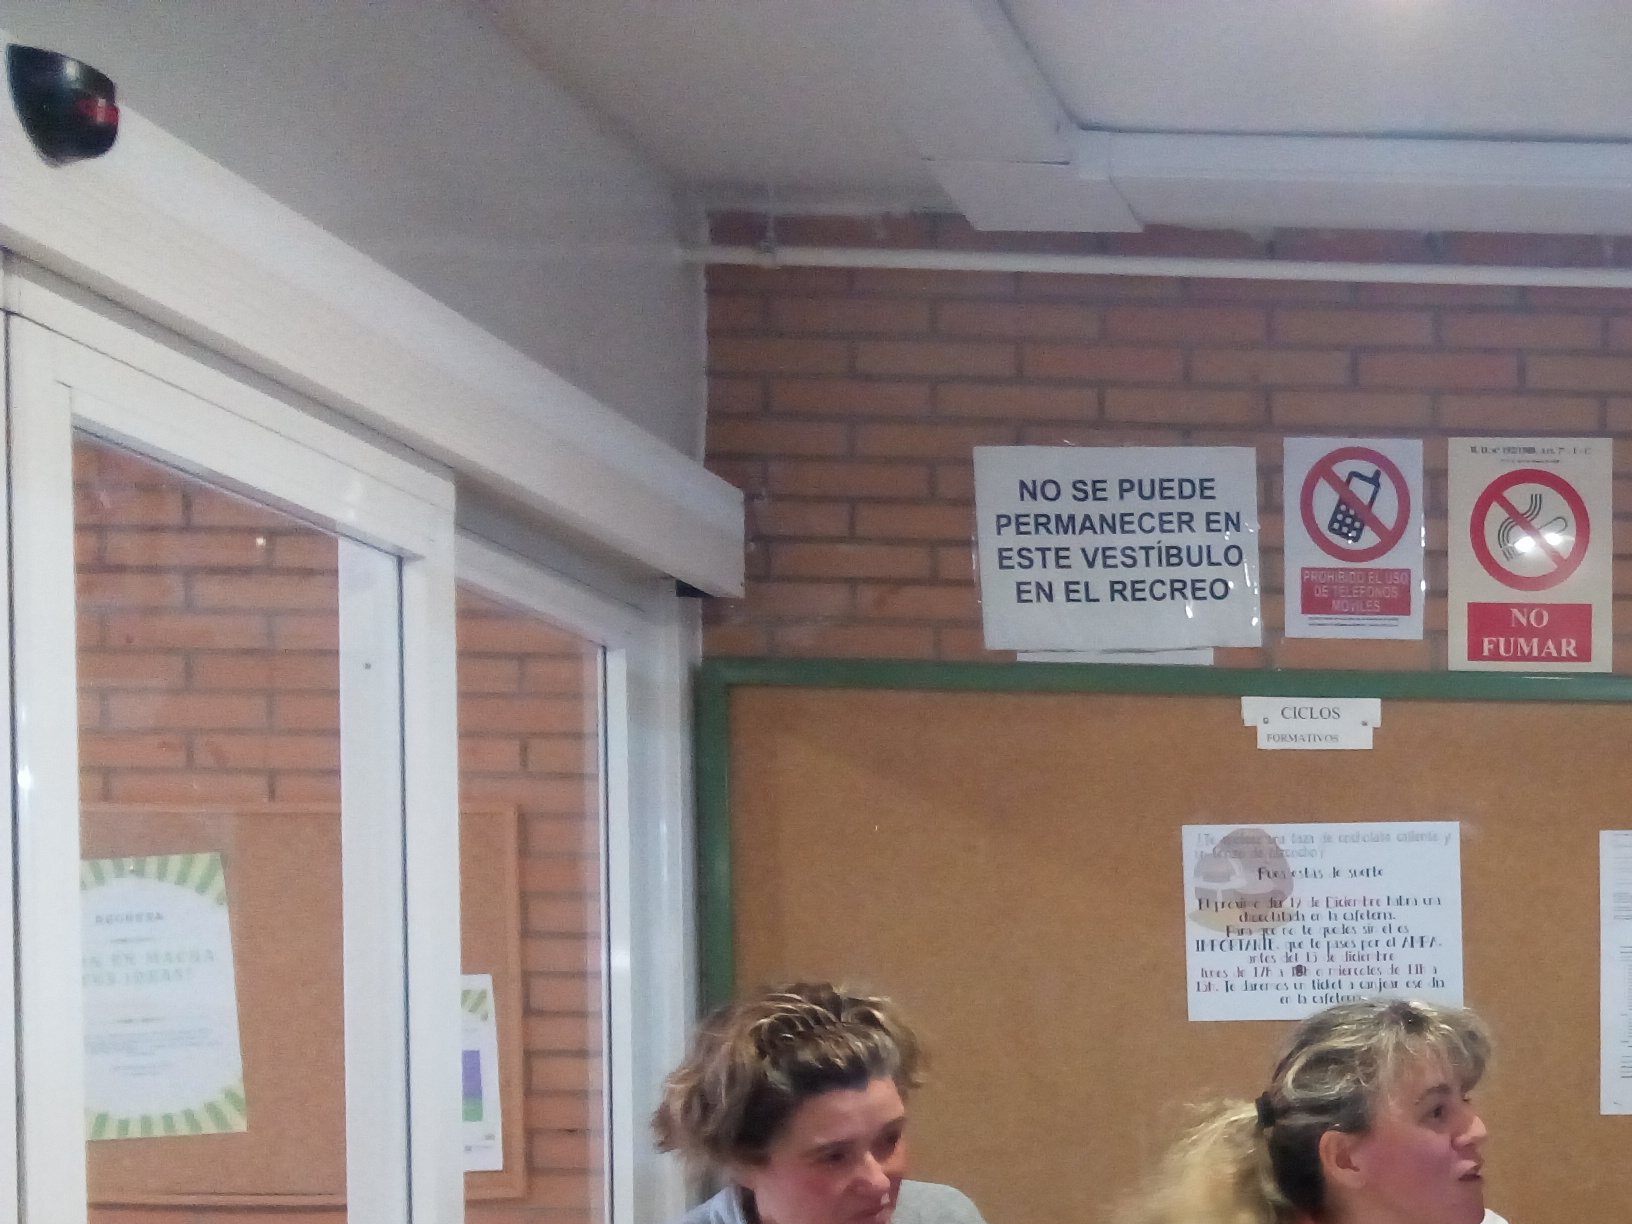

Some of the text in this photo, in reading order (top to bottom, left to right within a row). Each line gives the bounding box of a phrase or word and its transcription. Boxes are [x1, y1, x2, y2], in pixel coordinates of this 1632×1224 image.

[1018, 478, 1216, 502] NO SE PUEDE
[996, 511, 1241, 536] PERMANECER EN
[998, 540, 1243, 570] ESTE VESTÍBULO
[1303, 571, 1409, 584] PROHIBIDO EL USO
[1016, 578, 1230, 604] EN EL RECREO
[1314, 585, 1328, 597] DE
[1510, 608, 1549, 627] NO
[1482, 637, 1578, 657] FUMAR
[1281, 706, 1341, 720] CICLOS
[1266, 733, 1339, 743] FORMATIVOS
